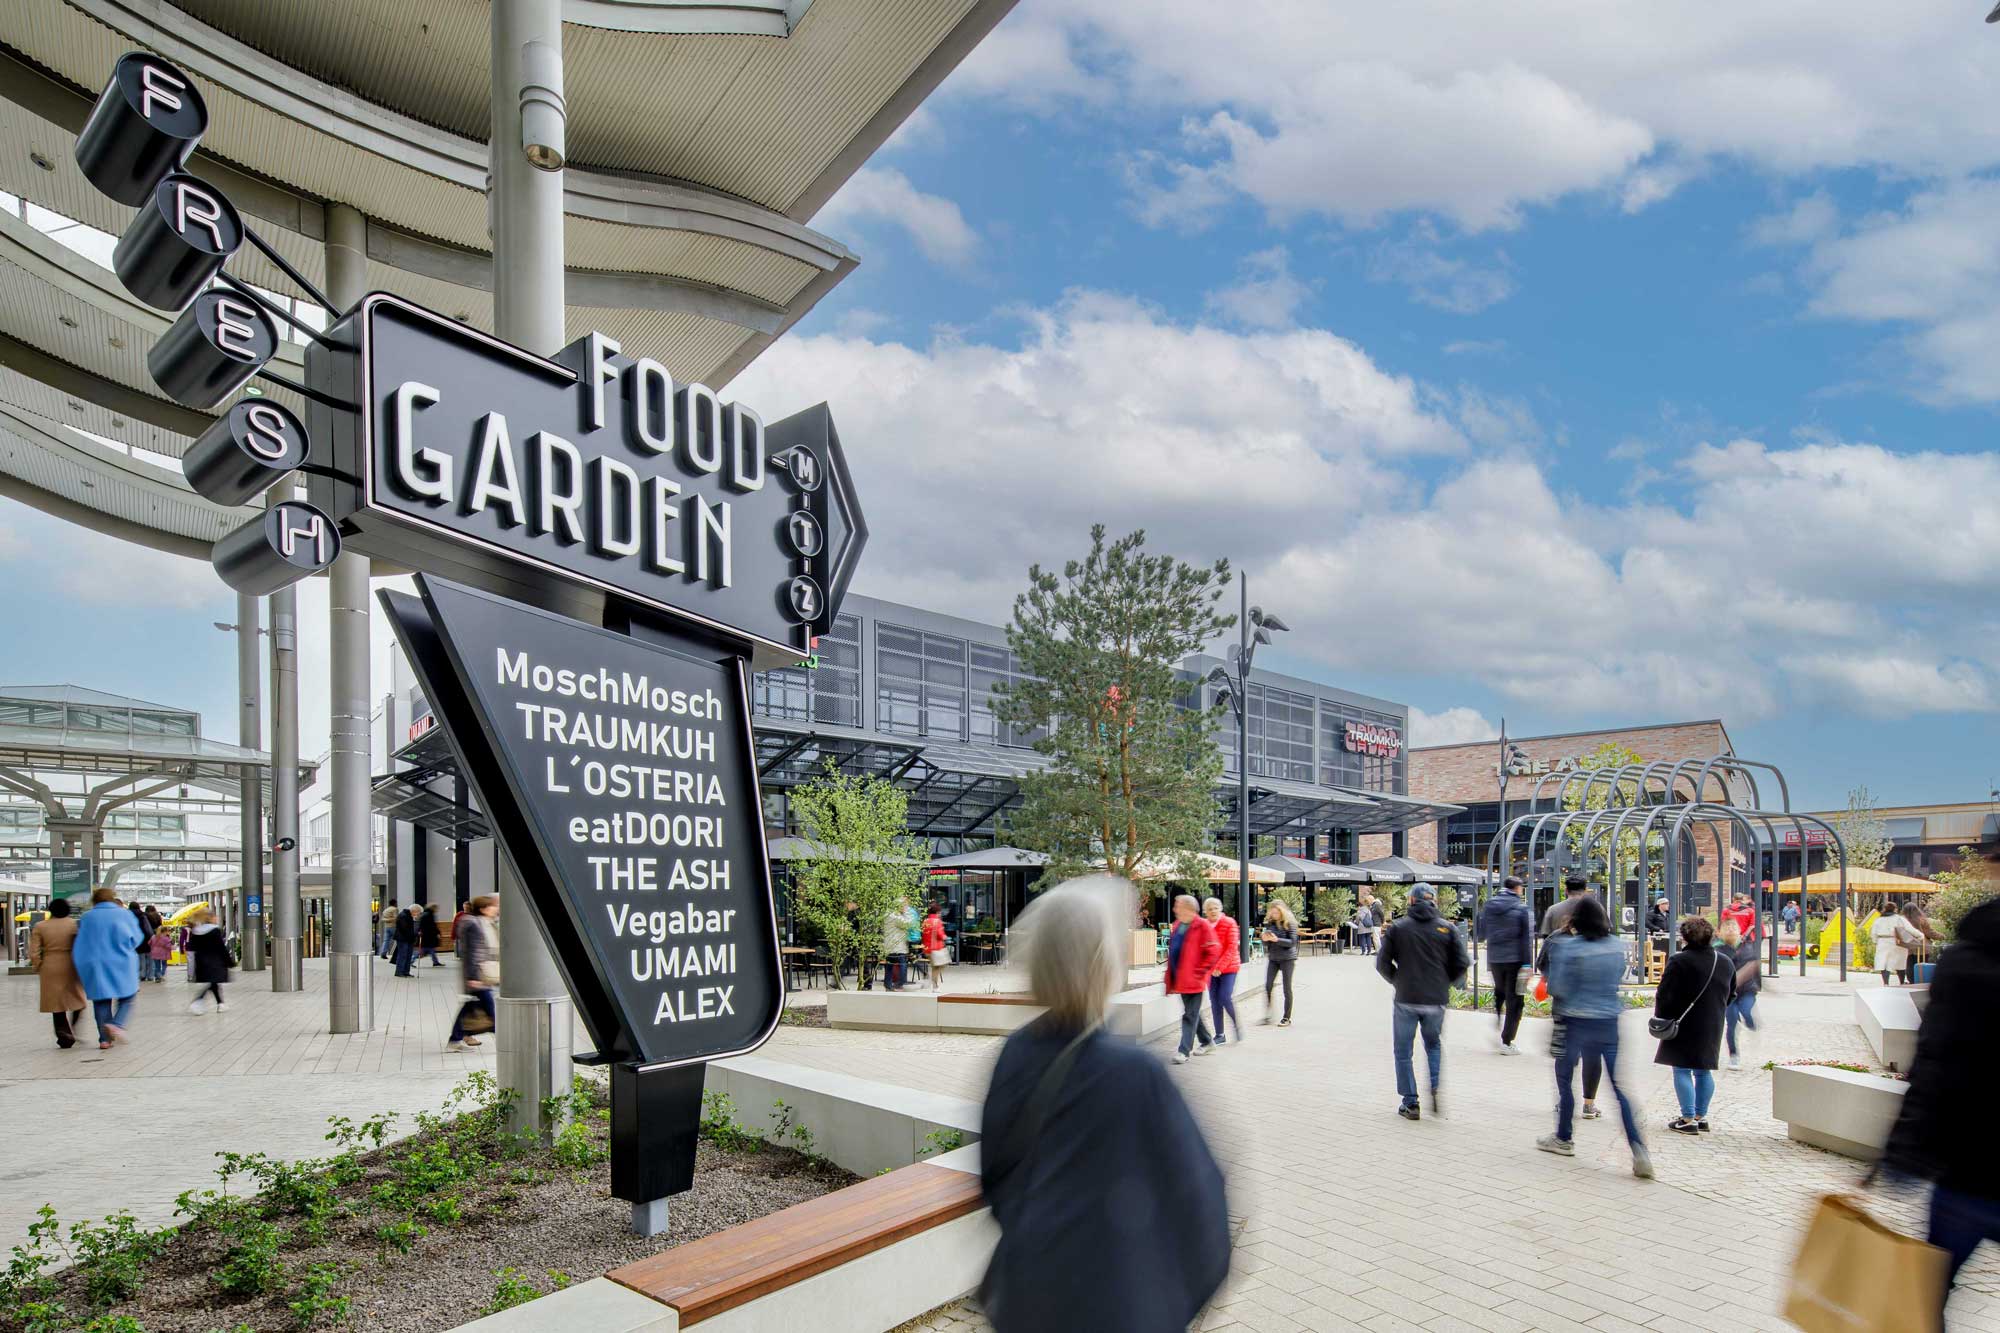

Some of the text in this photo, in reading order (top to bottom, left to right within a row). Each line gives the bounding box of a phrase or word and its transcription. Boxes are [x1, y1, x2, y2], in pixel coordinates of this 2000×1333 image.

[141, 64, 326, 564] FRESH
[589, 330, 765, 492] FOOD
[394, 381, 732, 589] GARDEN
[496, 646, 722, 721] MoschMosch
[516, 702, 715, 763] TRAUMKUH
[1349, 729, 1403, 749] TRAUMKUH
[569, 812, 723, 848] eatDOORI
[588, 856, 730, 891] THE ASH
[607, 903, 736, 943] Vegabar
[631, 944, 736, 982] UMAMI
[653, 986, 735, 1026] ALEX
